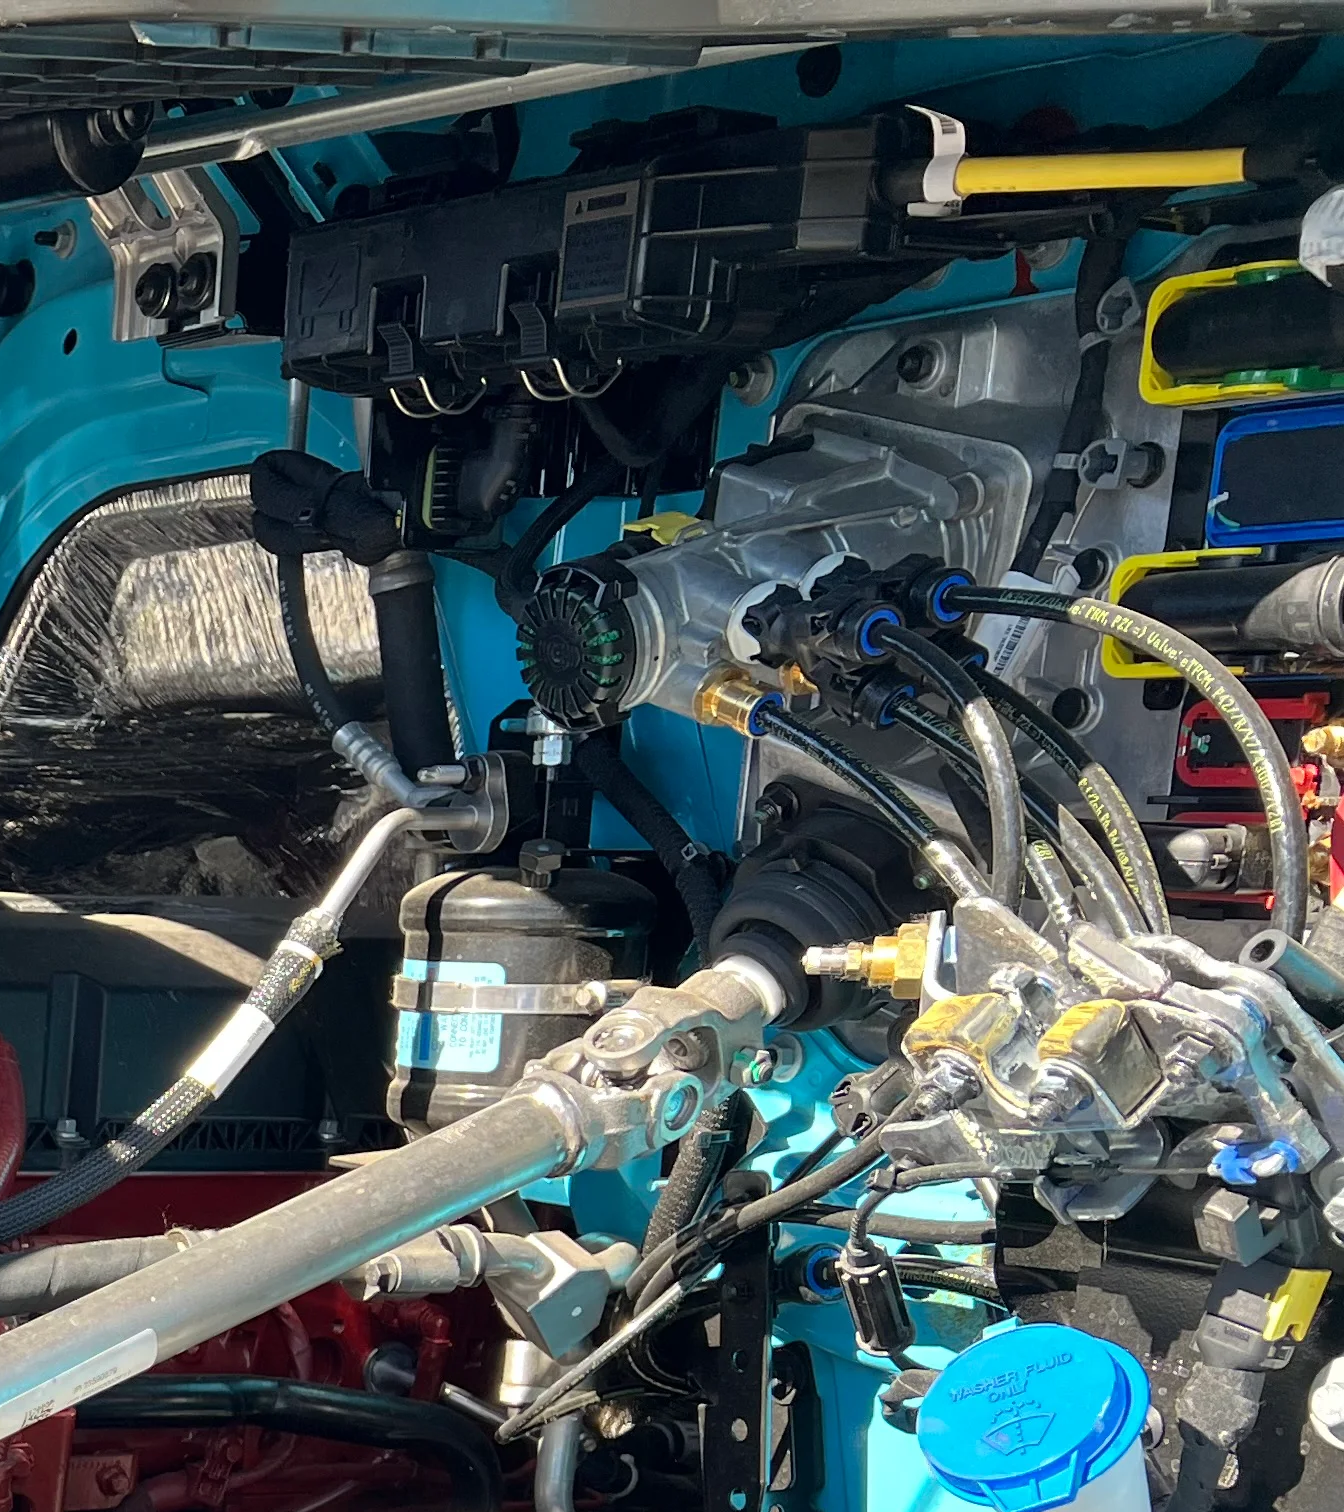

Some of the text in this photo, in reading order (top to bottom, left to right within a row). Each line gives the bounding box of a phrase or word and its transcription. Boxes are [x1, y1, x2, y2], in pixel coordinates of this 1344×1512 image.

[949, 1352, 1073, 1402] WASHER FLUID
[988, 1380, 1029, 1403] ONLY
